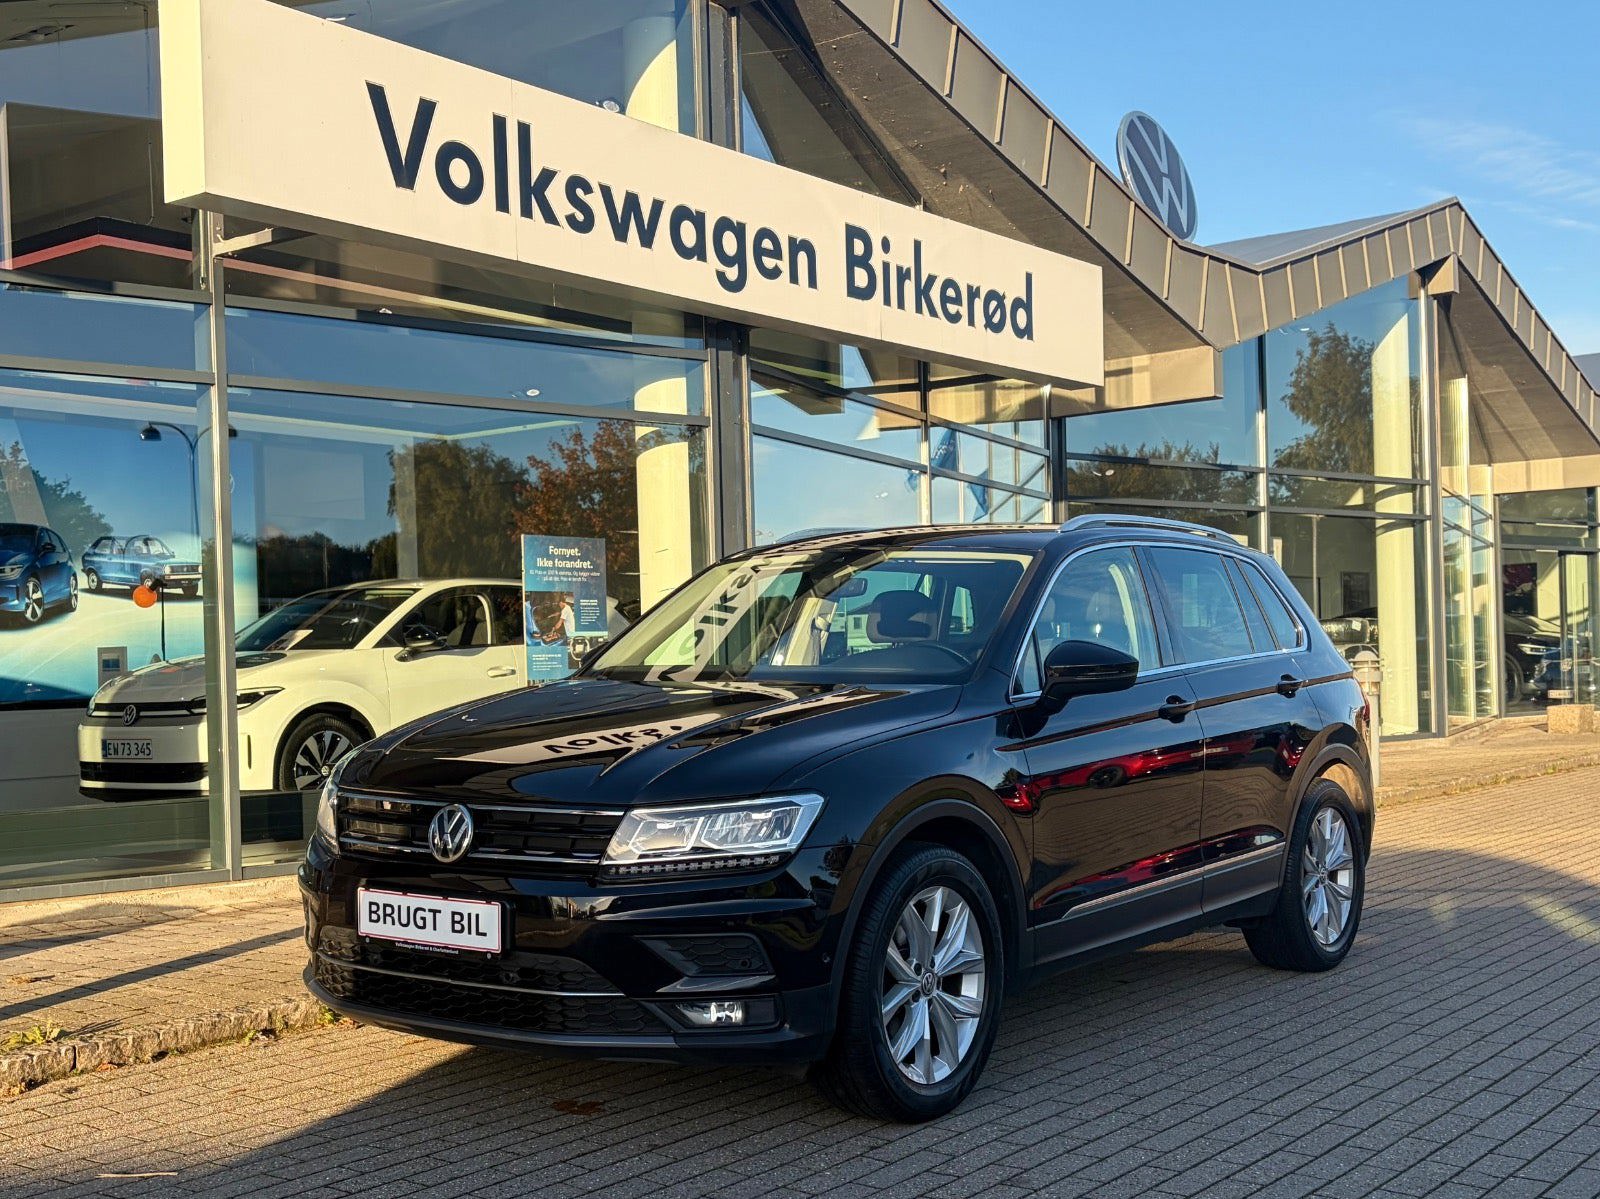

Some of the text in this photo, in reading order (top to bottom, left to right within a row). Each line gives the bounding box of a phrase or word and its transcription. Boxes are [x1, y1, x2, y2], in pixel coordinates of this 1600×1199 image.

[1118, 112, 1196, 239] VW
[366, 80, 1035, 341] Volkswagen Birkerød
[536, 557, 594, 569] Ikke forandret.
[548, 545, 581, 558] Fornyet.
[121, 742, 132, 757] 73
[134, 742, 151, 757] 345
[368, 901, 488, 937] BRUGT BIL
